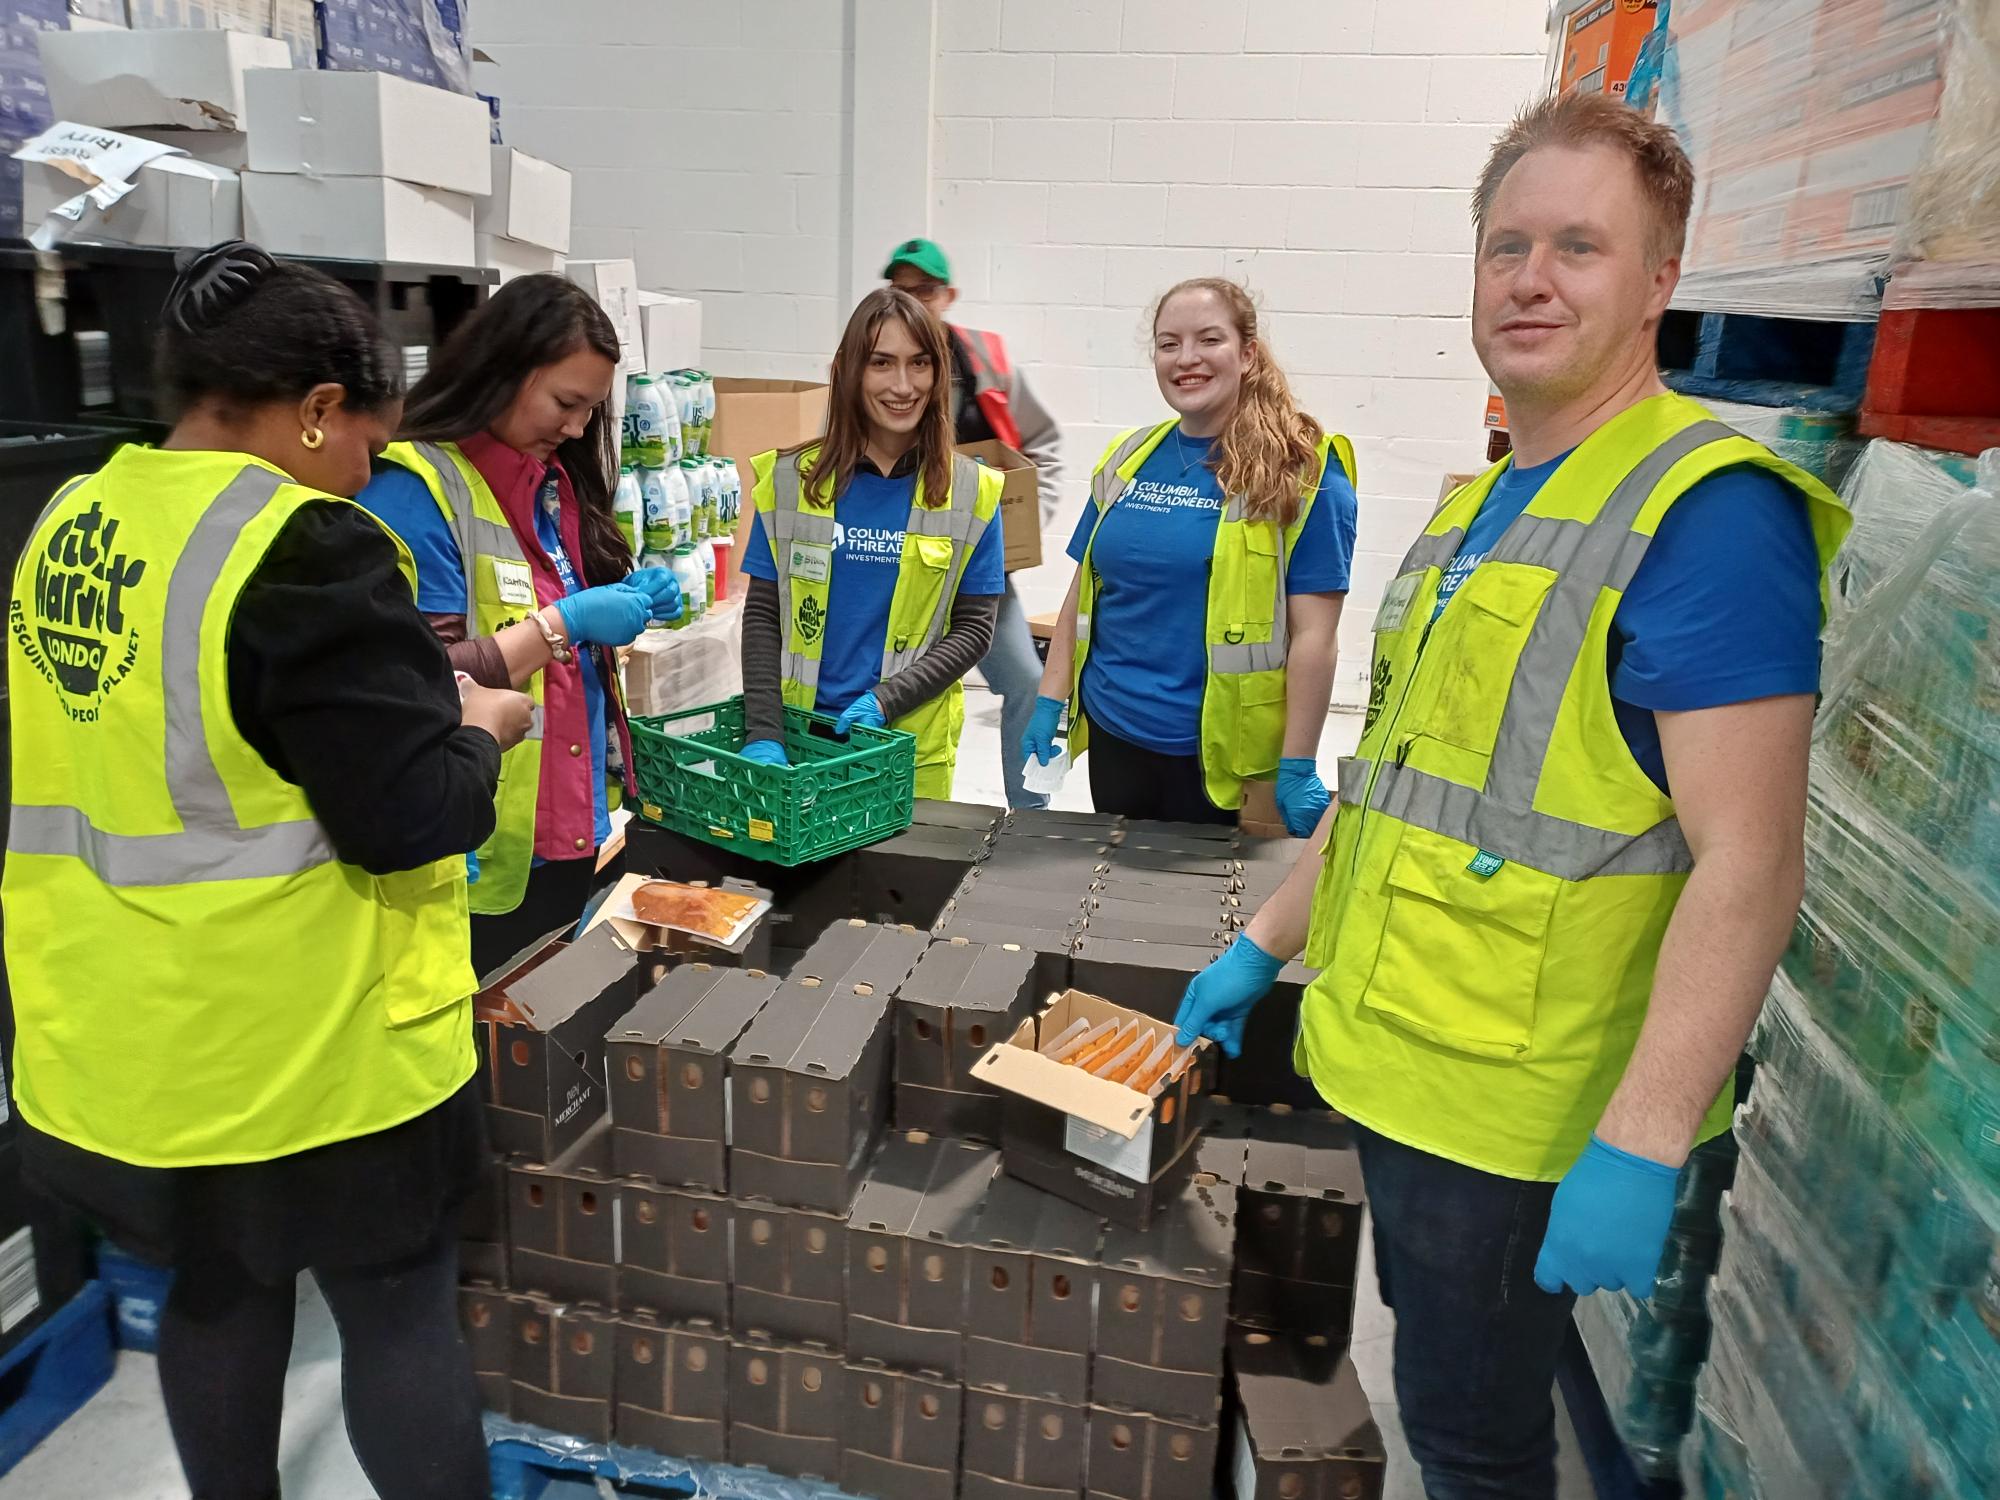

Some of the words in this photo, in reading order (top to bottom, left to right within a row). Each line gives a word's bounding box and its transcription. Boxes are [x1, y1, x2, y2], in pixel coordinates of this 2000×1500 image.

[1612, 82, 1627, 92] 43
[60, 131, 122, 150] RITY
[622, 414, 640, 433] ST
[1138, 482, 1199, 497] COLUMBIA
[1125, 502, 1172, 514] INVESTMENTS
[1132, 490, 1221, 511] THREADNEEDL
[847, 527, 907, 543] COLUMB
[847, 539, 903, 554] THREAD
[46, 635, 101, 671] LONDO
[102, 627, 140, 695] PLANET
